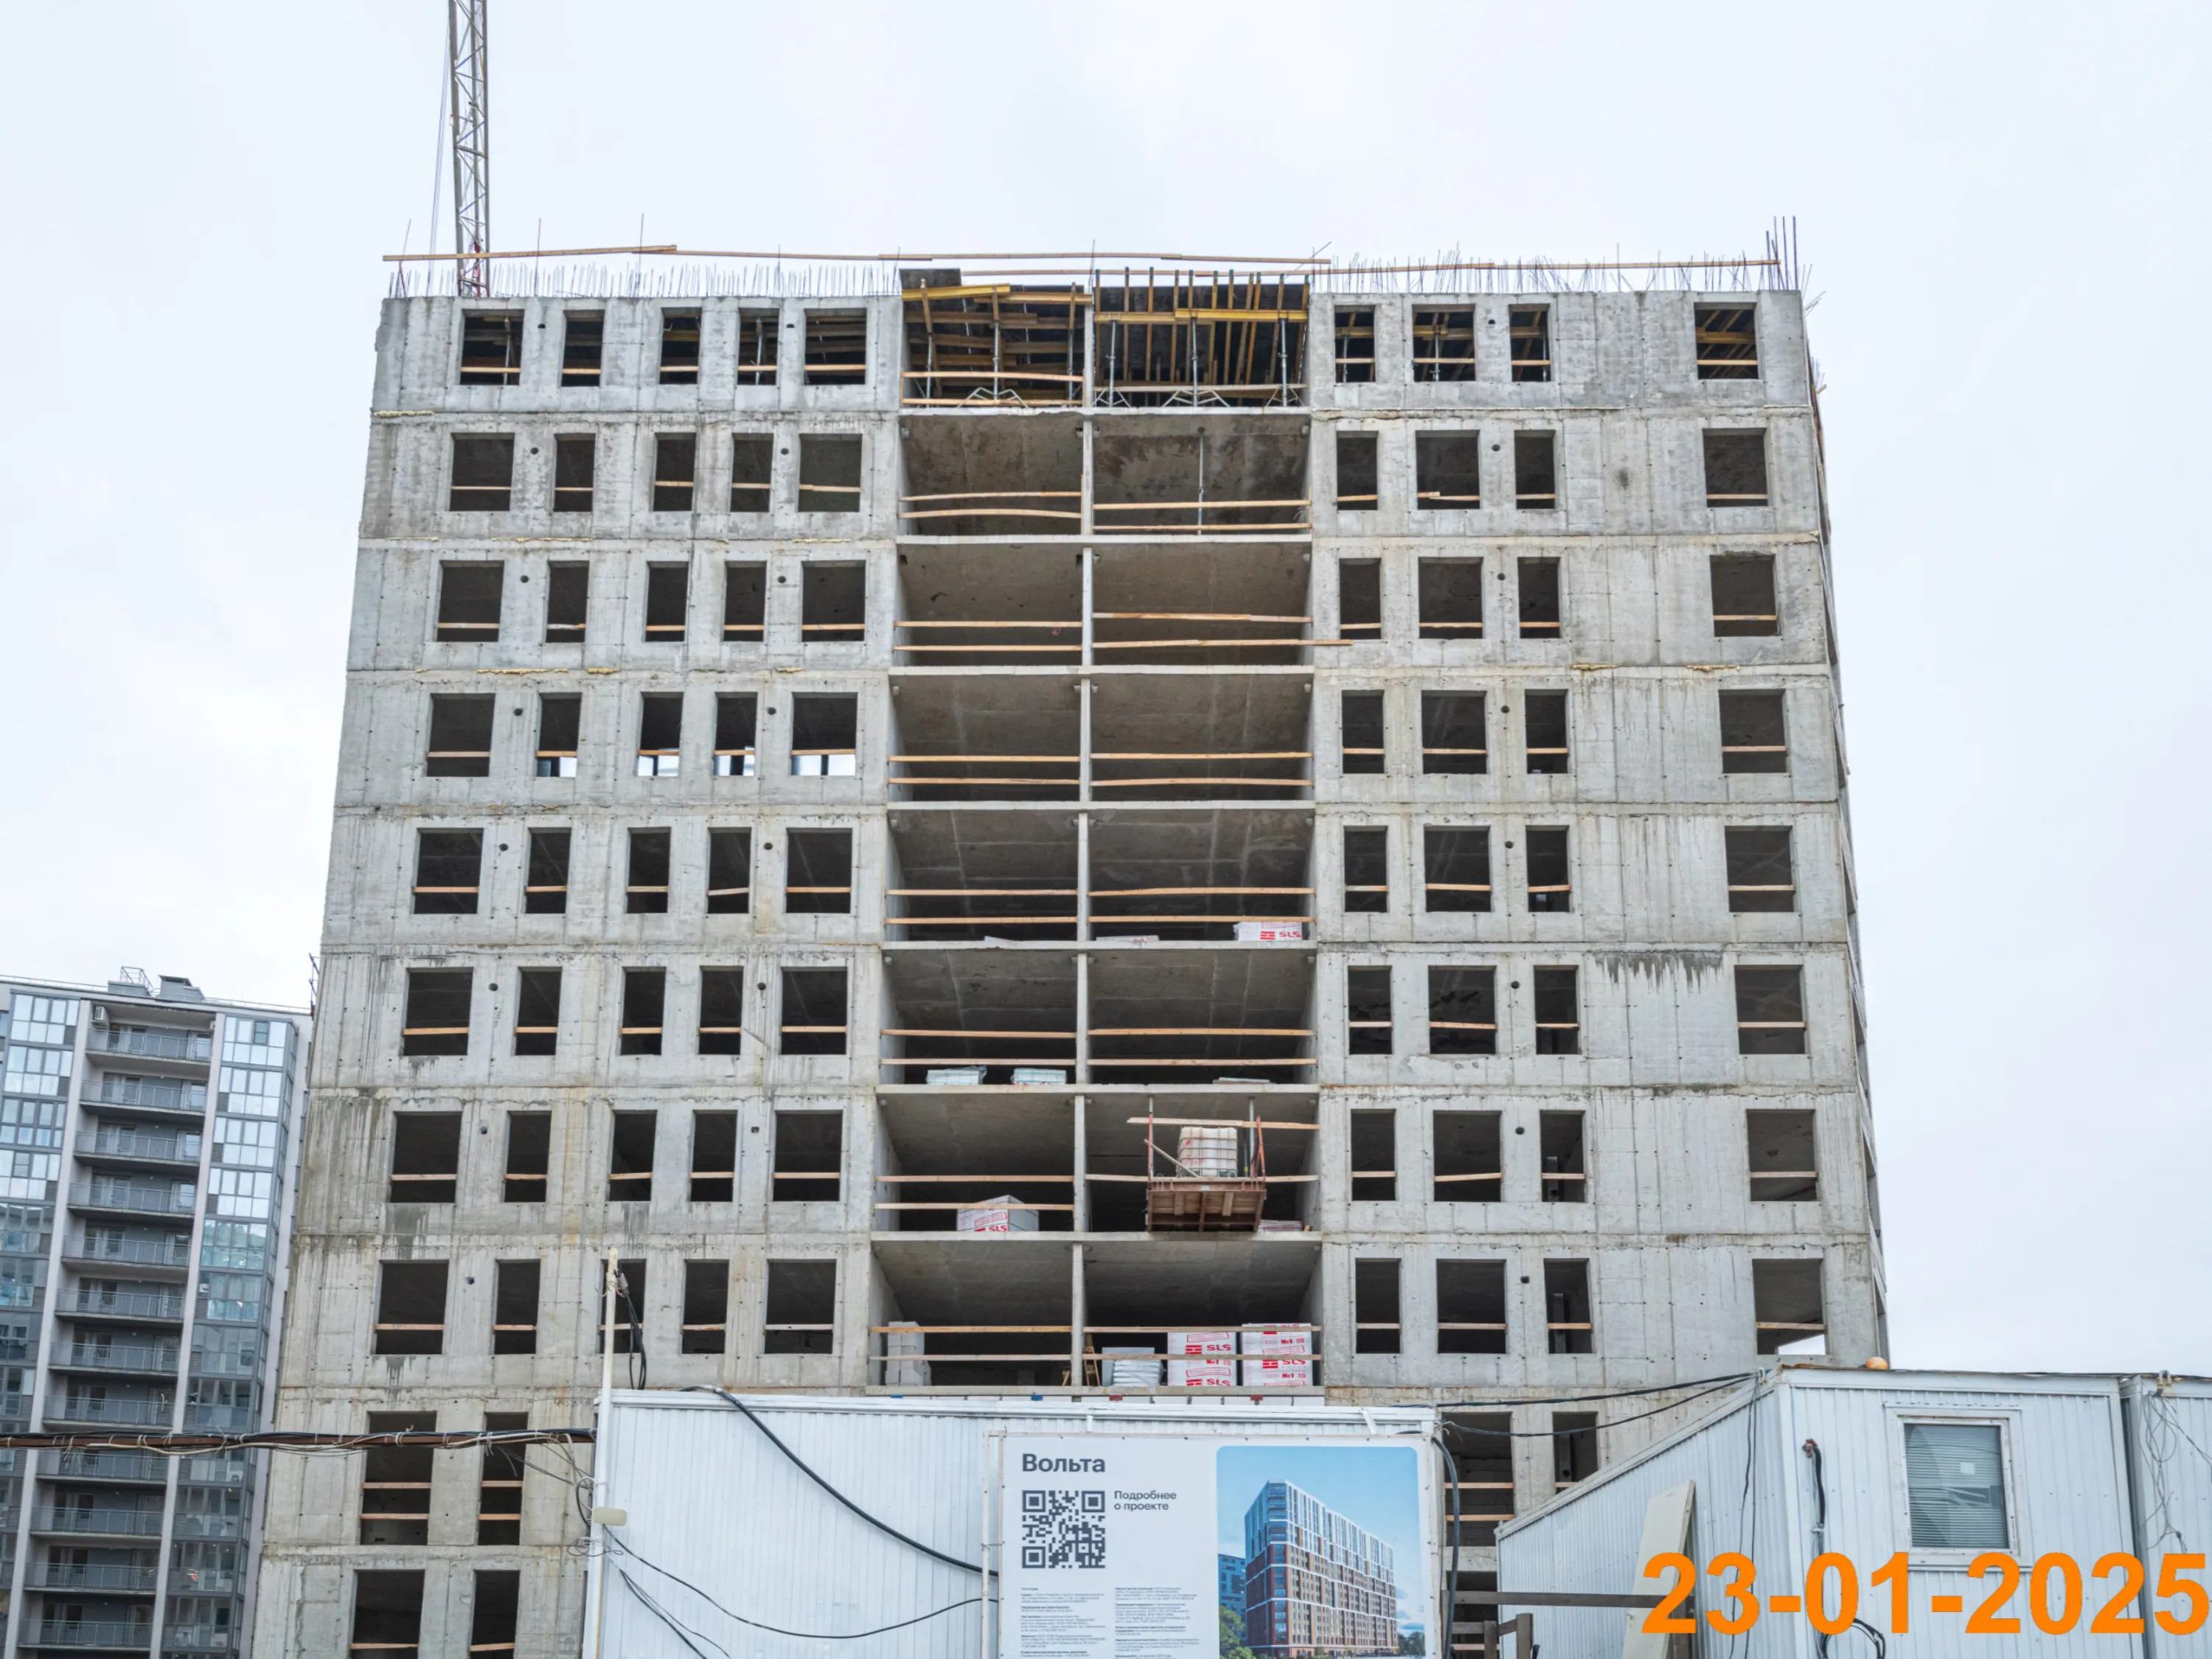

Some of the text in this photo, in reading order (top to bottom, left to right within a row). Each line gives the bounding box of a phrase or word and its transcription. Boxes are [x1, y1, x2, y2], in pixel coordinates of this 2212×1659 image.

[1206, 1343, 1232, 1352] SLS
[1206, 1378, 1232, 1386] SLS
[1022, 1453, 1105, 1472] Вольта
[1114, 1489, 1177, 1500] Подробнее
[1124, 1503, 1169, 1512] проекте
